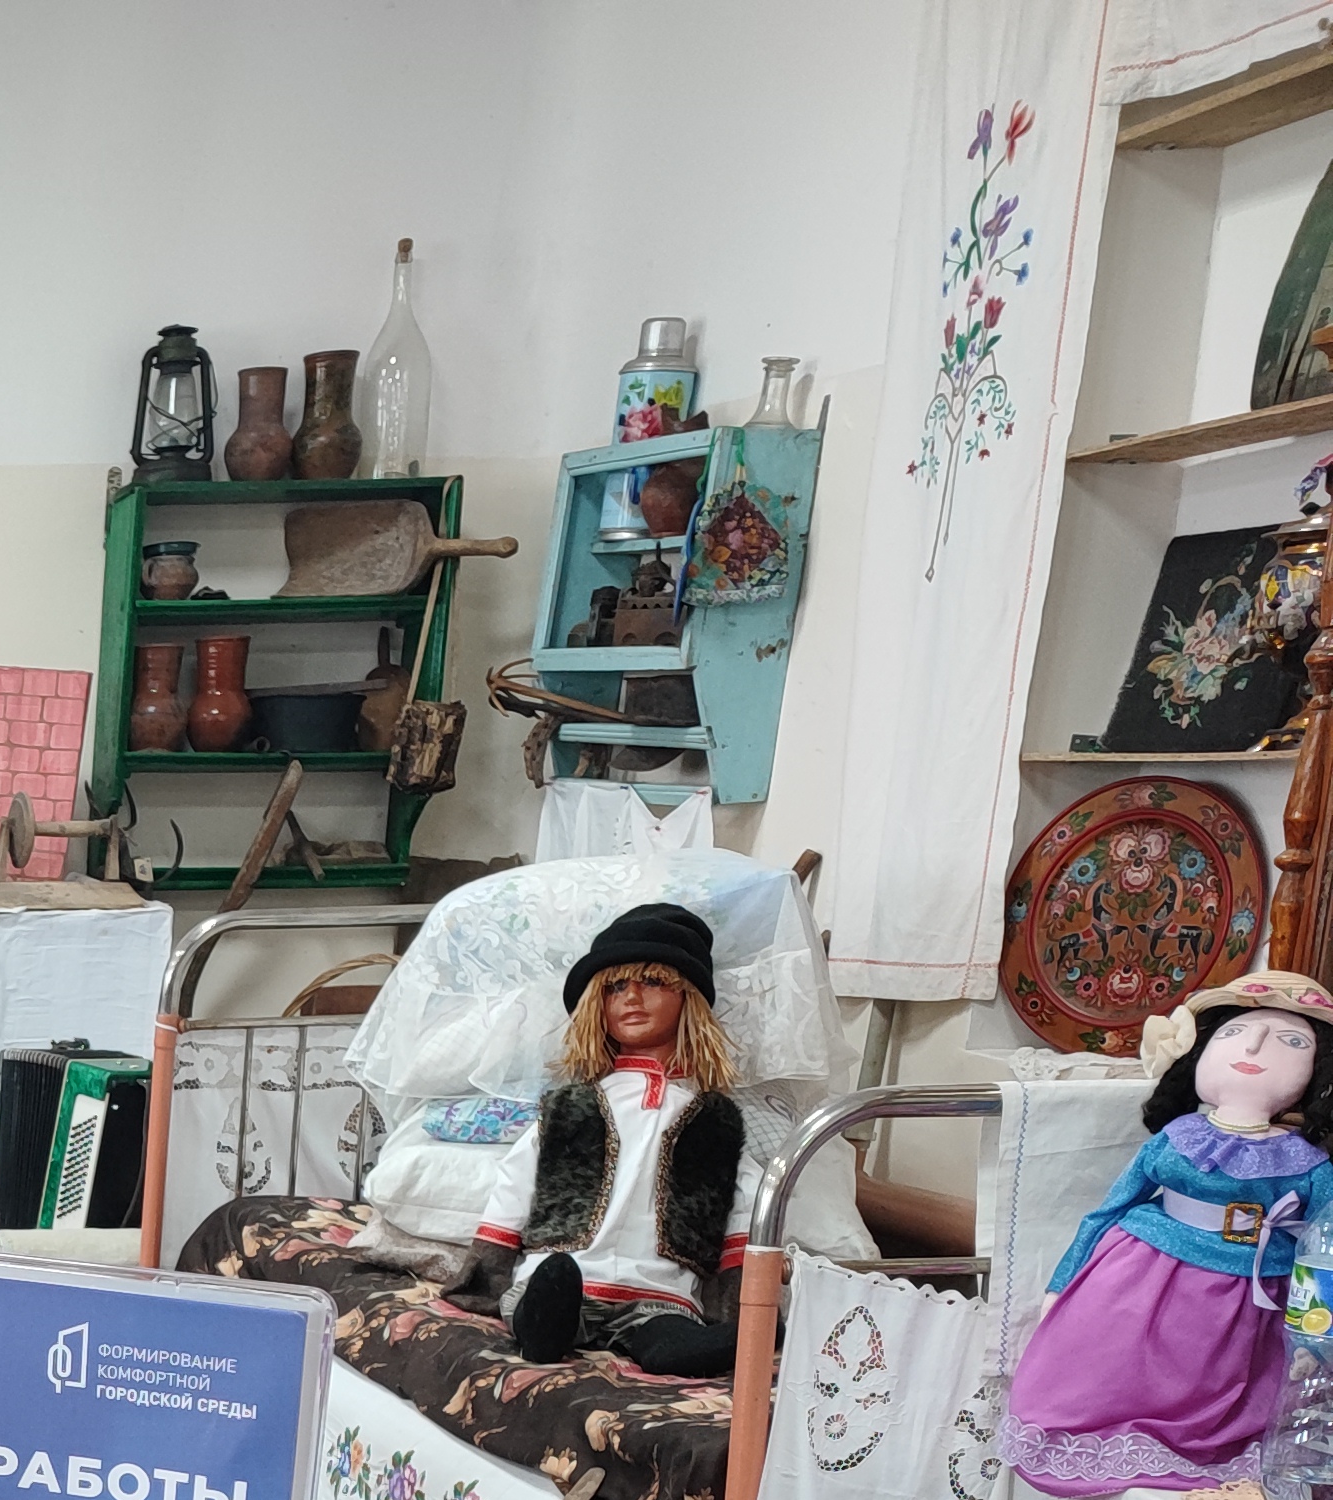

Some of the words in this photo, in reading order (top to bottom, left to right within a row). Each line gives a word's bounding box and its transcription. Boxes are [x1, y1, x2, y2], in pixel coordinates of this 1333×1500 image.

[98, 1343, 237, 1374] ФОРМИРОВАНИЕ
[97, 1364, 211, 1392] КОМФОРТНОЙ
[96, 1384, 193, 1411] ГОРОДСКОЙ
[196, 1396, 257, 1420] СРЕДЫ
